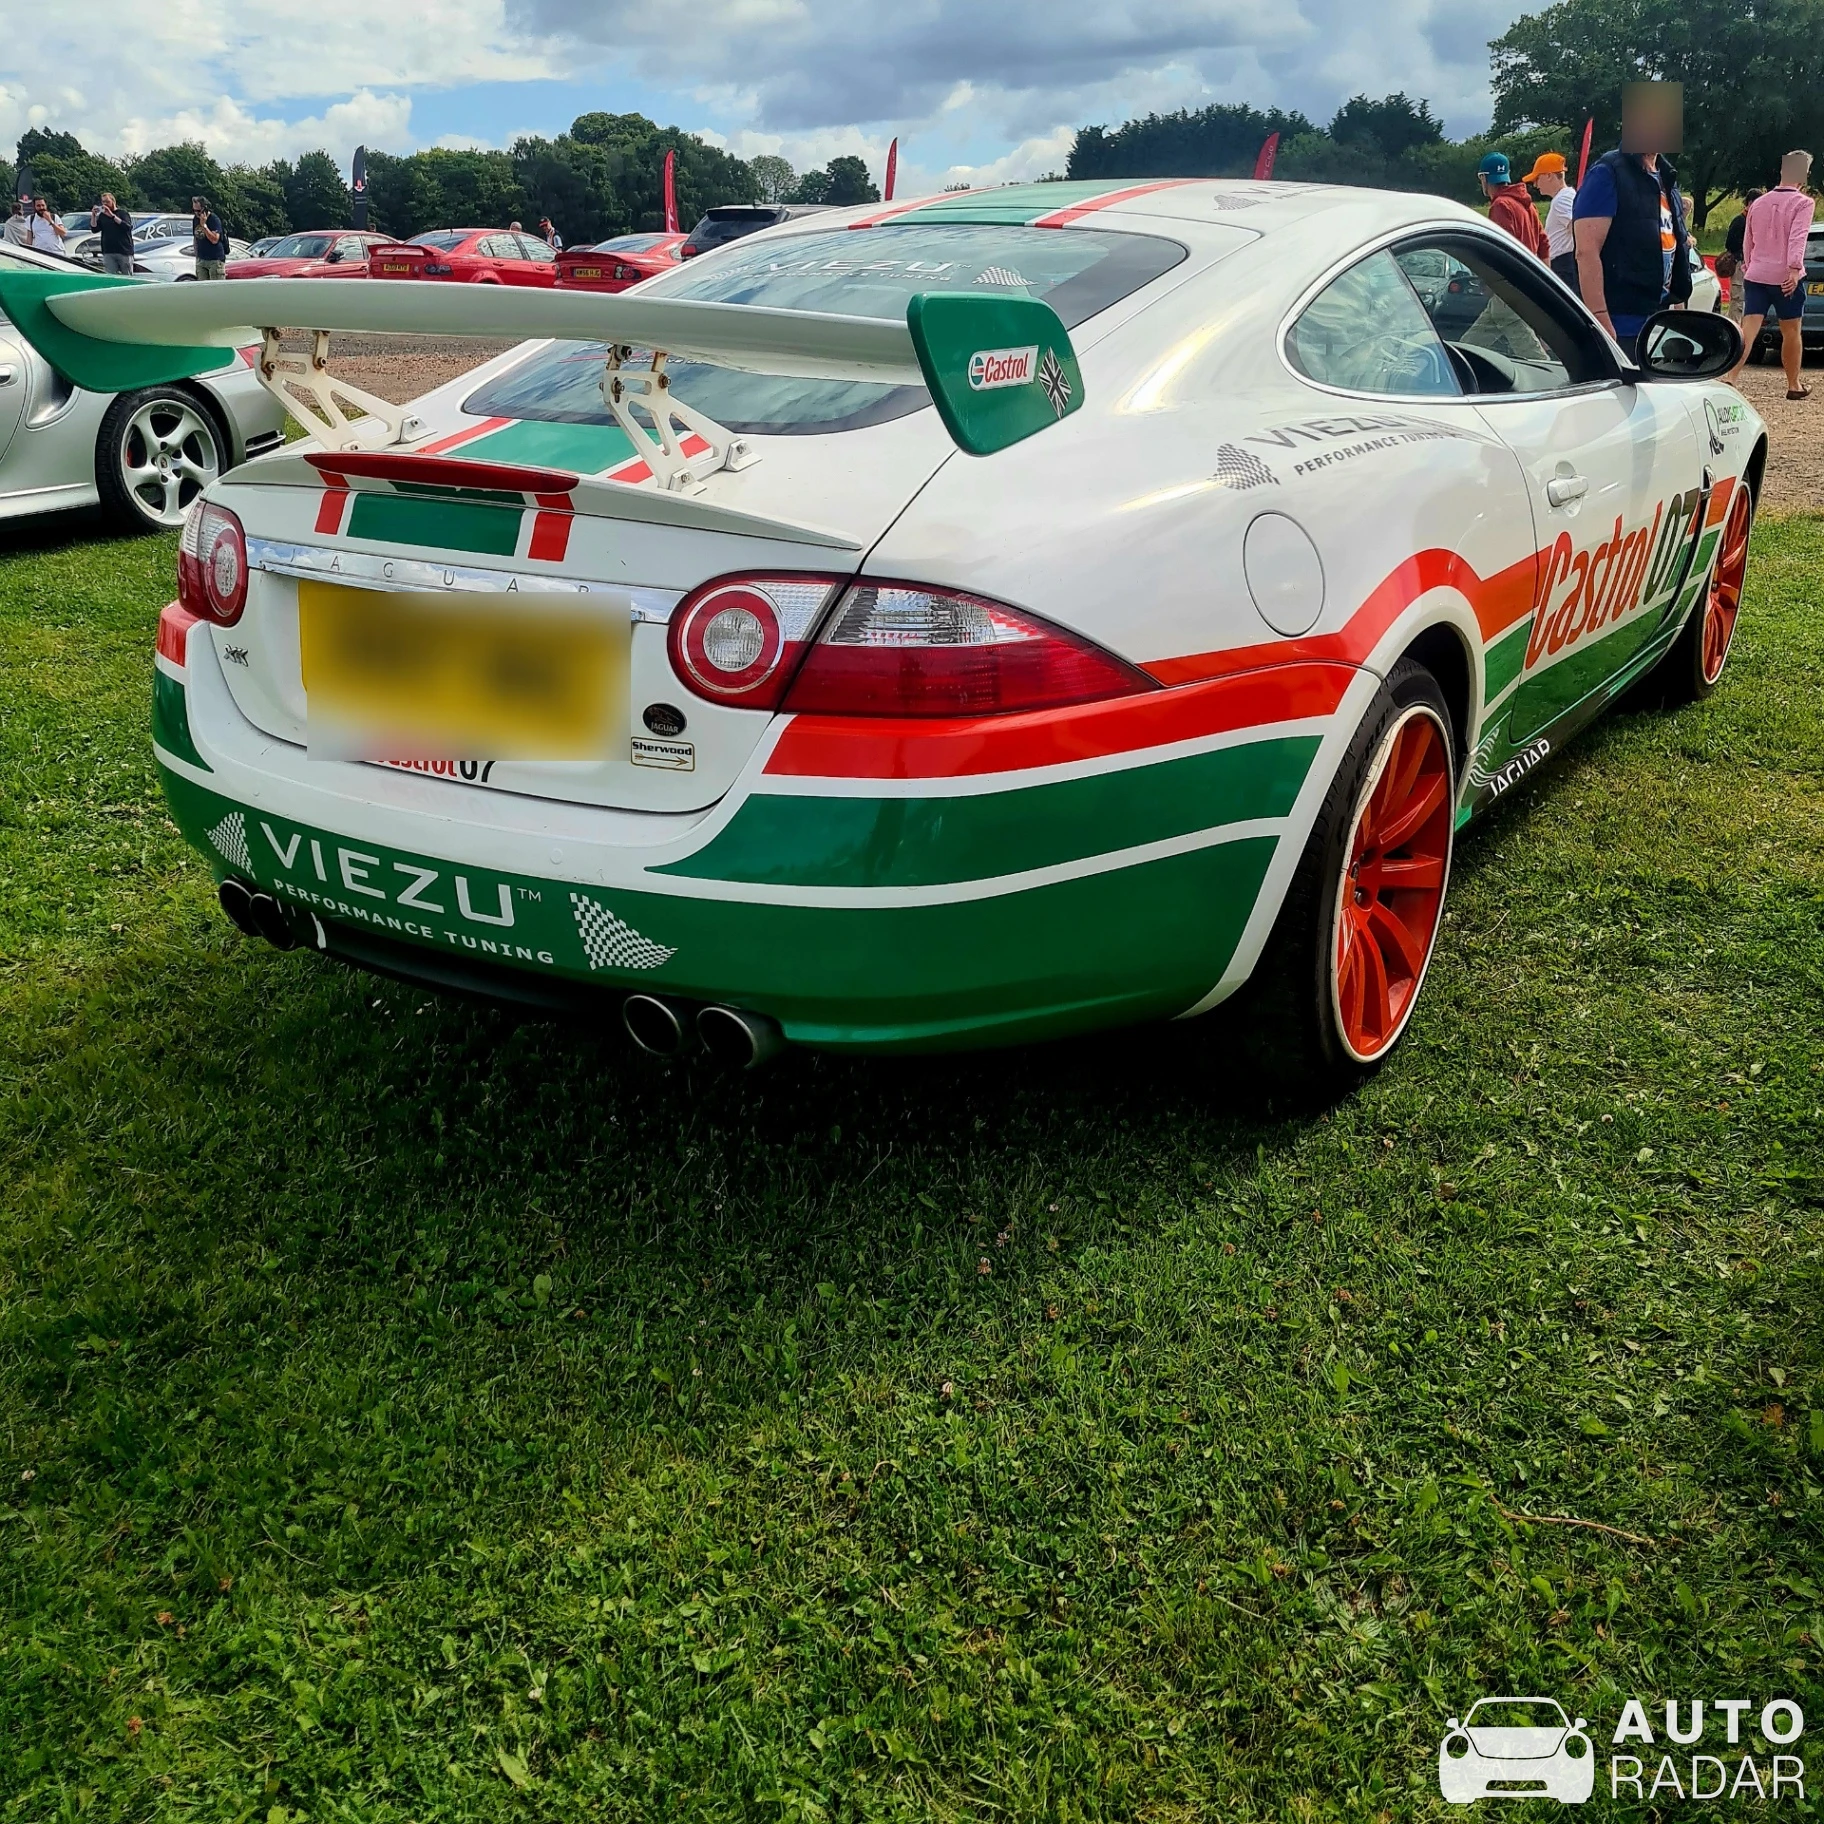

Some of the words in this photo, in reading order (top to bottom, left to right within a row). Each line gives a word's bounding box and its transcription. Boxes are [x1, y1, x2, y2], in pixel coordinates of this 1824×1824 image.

[769, 259, 953, 273] VIEZU
[984, 352, 1029, 383] Castrol
[1244, 415, 1407, 449] VIEZU
[1293, 436, 1399, 476] PERFORMANCE
[650, 721, 680, 734] JAGUAR
[632, 741, 693, 756] Sherwood
[259, 821, 515, 928] VIEZU
[273, 878, 434, 939] PERFORMANCE
[444, 930, 554, 965] TUNING
